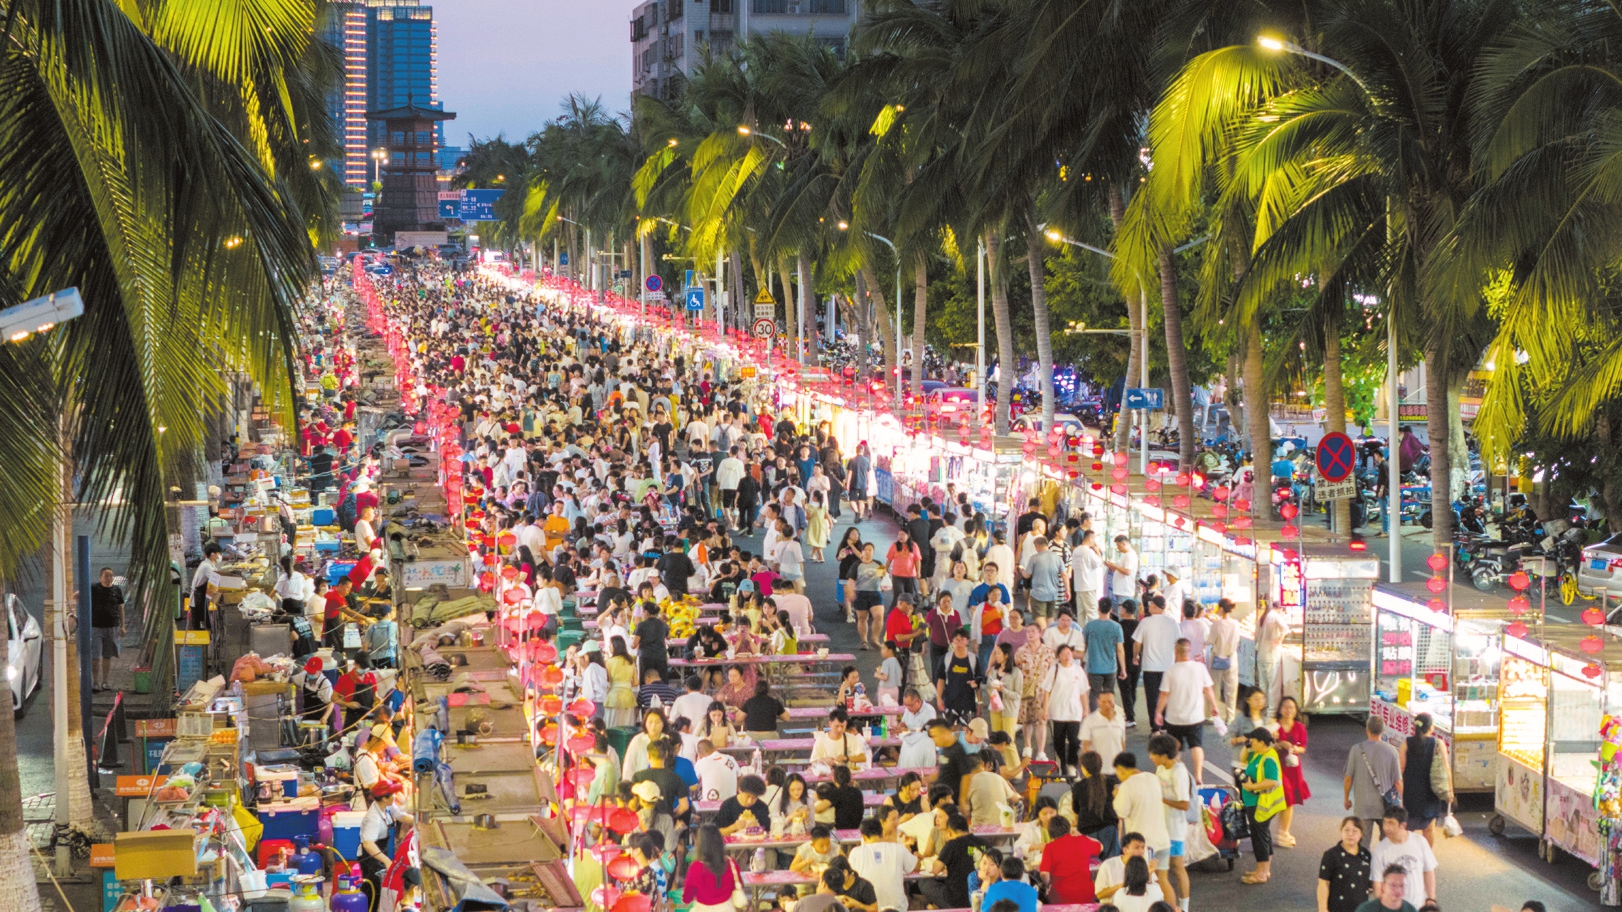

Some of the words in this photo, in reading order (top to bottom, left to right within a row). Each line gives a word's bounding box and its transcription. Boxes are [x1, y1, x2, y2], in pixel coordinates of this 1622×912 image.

[758, 323, 772, 335] 30
[1317, 486, 1355, 500] 违者抓拍
